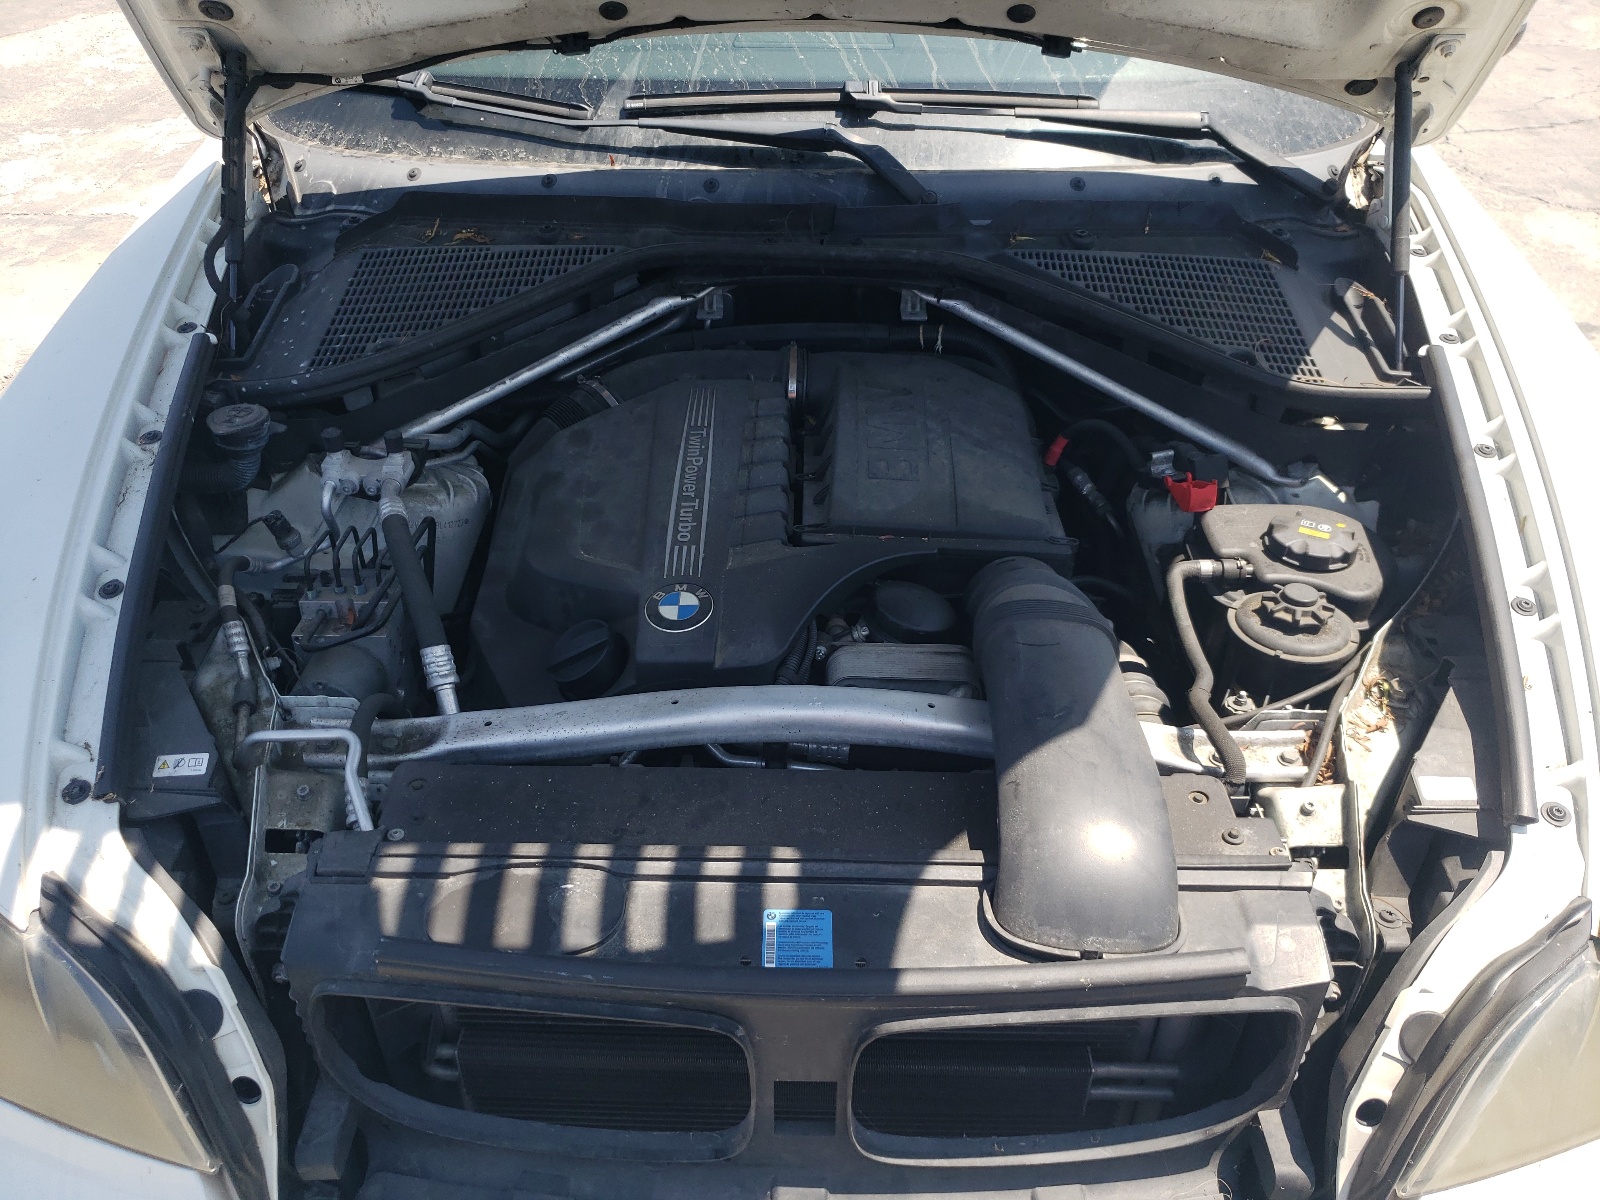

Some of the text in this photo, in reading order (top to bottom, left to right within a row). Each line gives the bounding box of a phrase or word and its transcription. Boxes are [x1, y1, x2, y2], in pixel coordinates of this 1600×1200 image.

[864, 382, 920, 481] BMW
[677, 428, 707, 542] TwinPower Turbo
[653, 584, 709, 600] BMW
